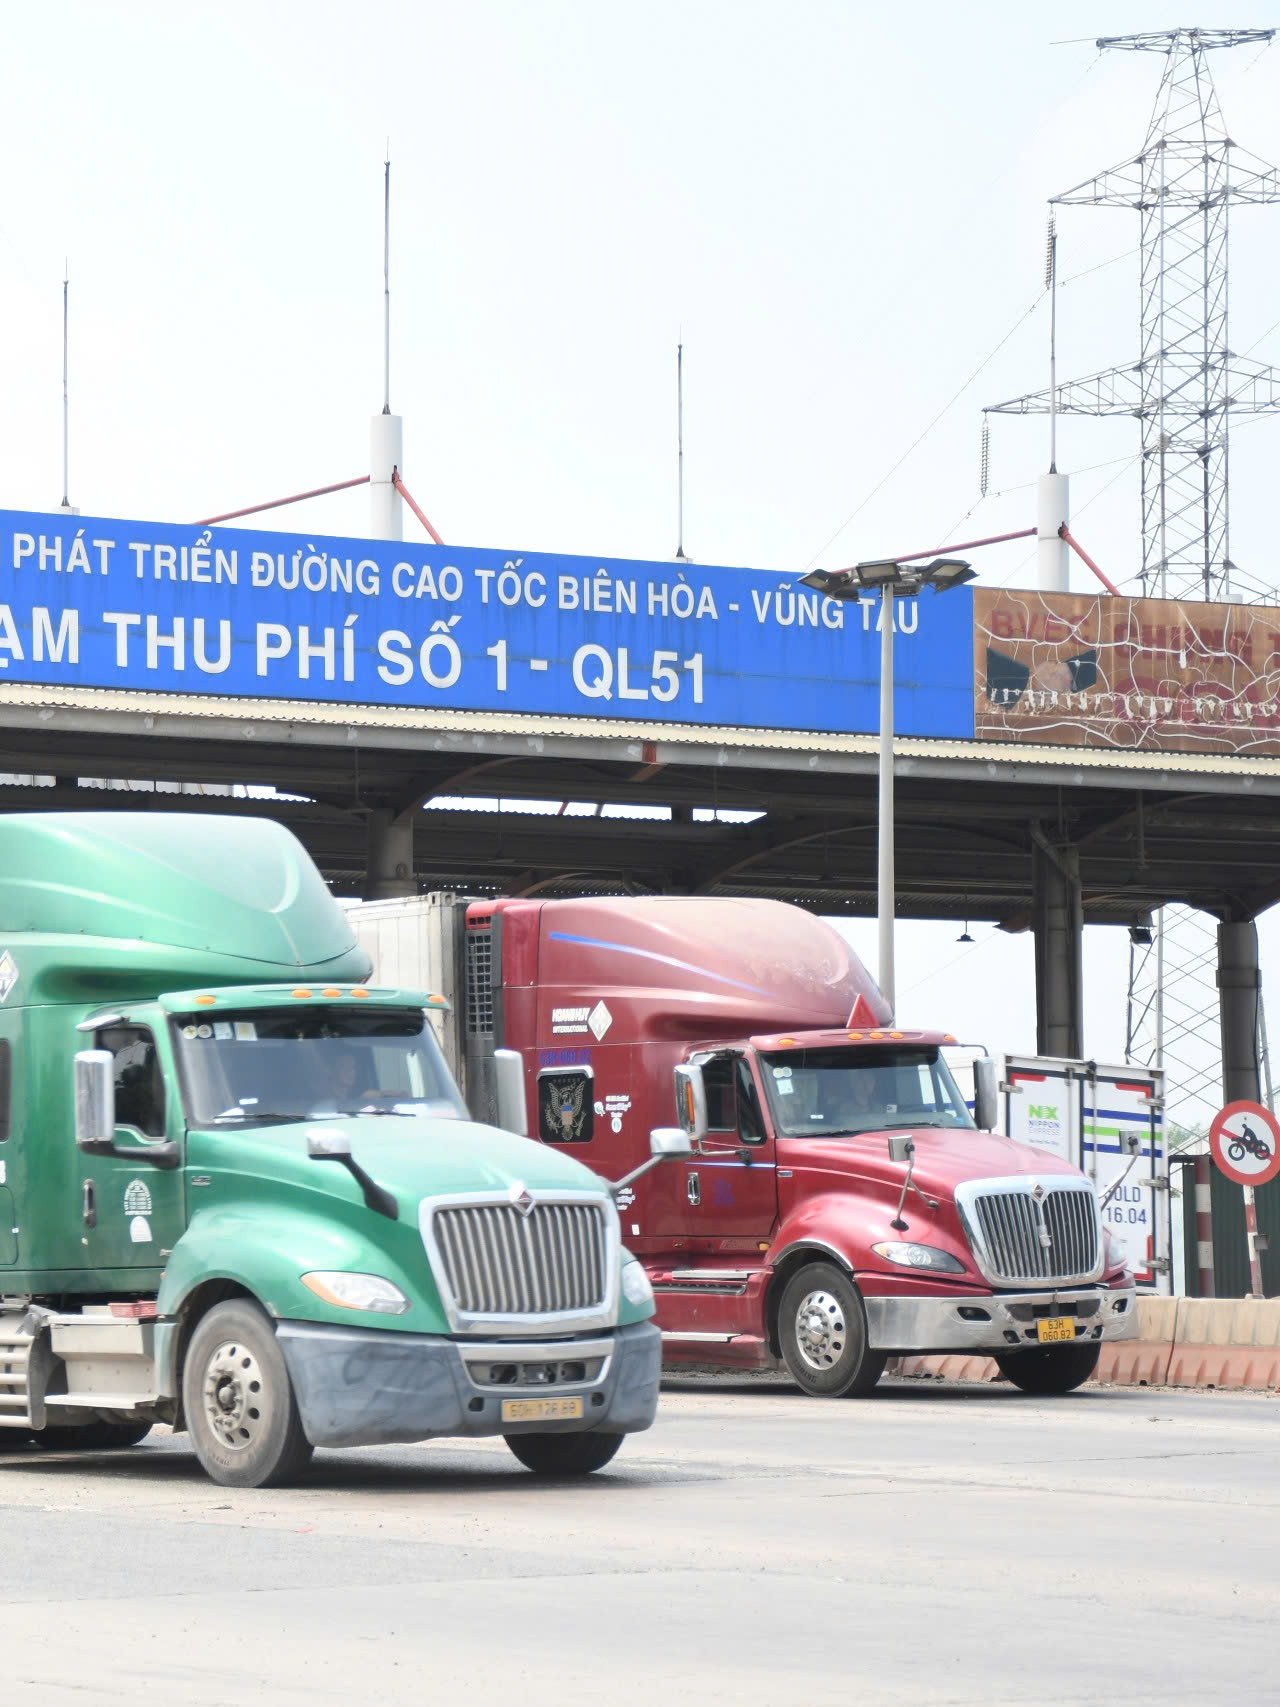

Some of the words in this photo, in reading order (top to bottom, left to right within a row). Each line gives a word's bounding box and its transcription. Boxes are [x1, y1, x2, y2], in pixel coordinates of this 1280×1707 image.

[13, 529, 116, 575] PHÁT
[128, 530, 238, 585] TRIỂN
[250, 544, 380, 597] ĐƯỜNG
[392, 562, 463, 603] CAO
[474, 559, 547, 608] TỐC
[558, 568, 637, 614] BIÊN
[648, 572, 718, 620] HÒA
[729, 603, 739, 612] -
[751, 583, 845, 630] VŨNG
[102, 612, 231, 674] THU
[256, 614, 359, 682] PHÍ
[377, 615, 462, 689] SỐ
[487, 640, 507, 691] 1
[530, 660, 548, 671] -
[573, 645, 703, 704] QL51
